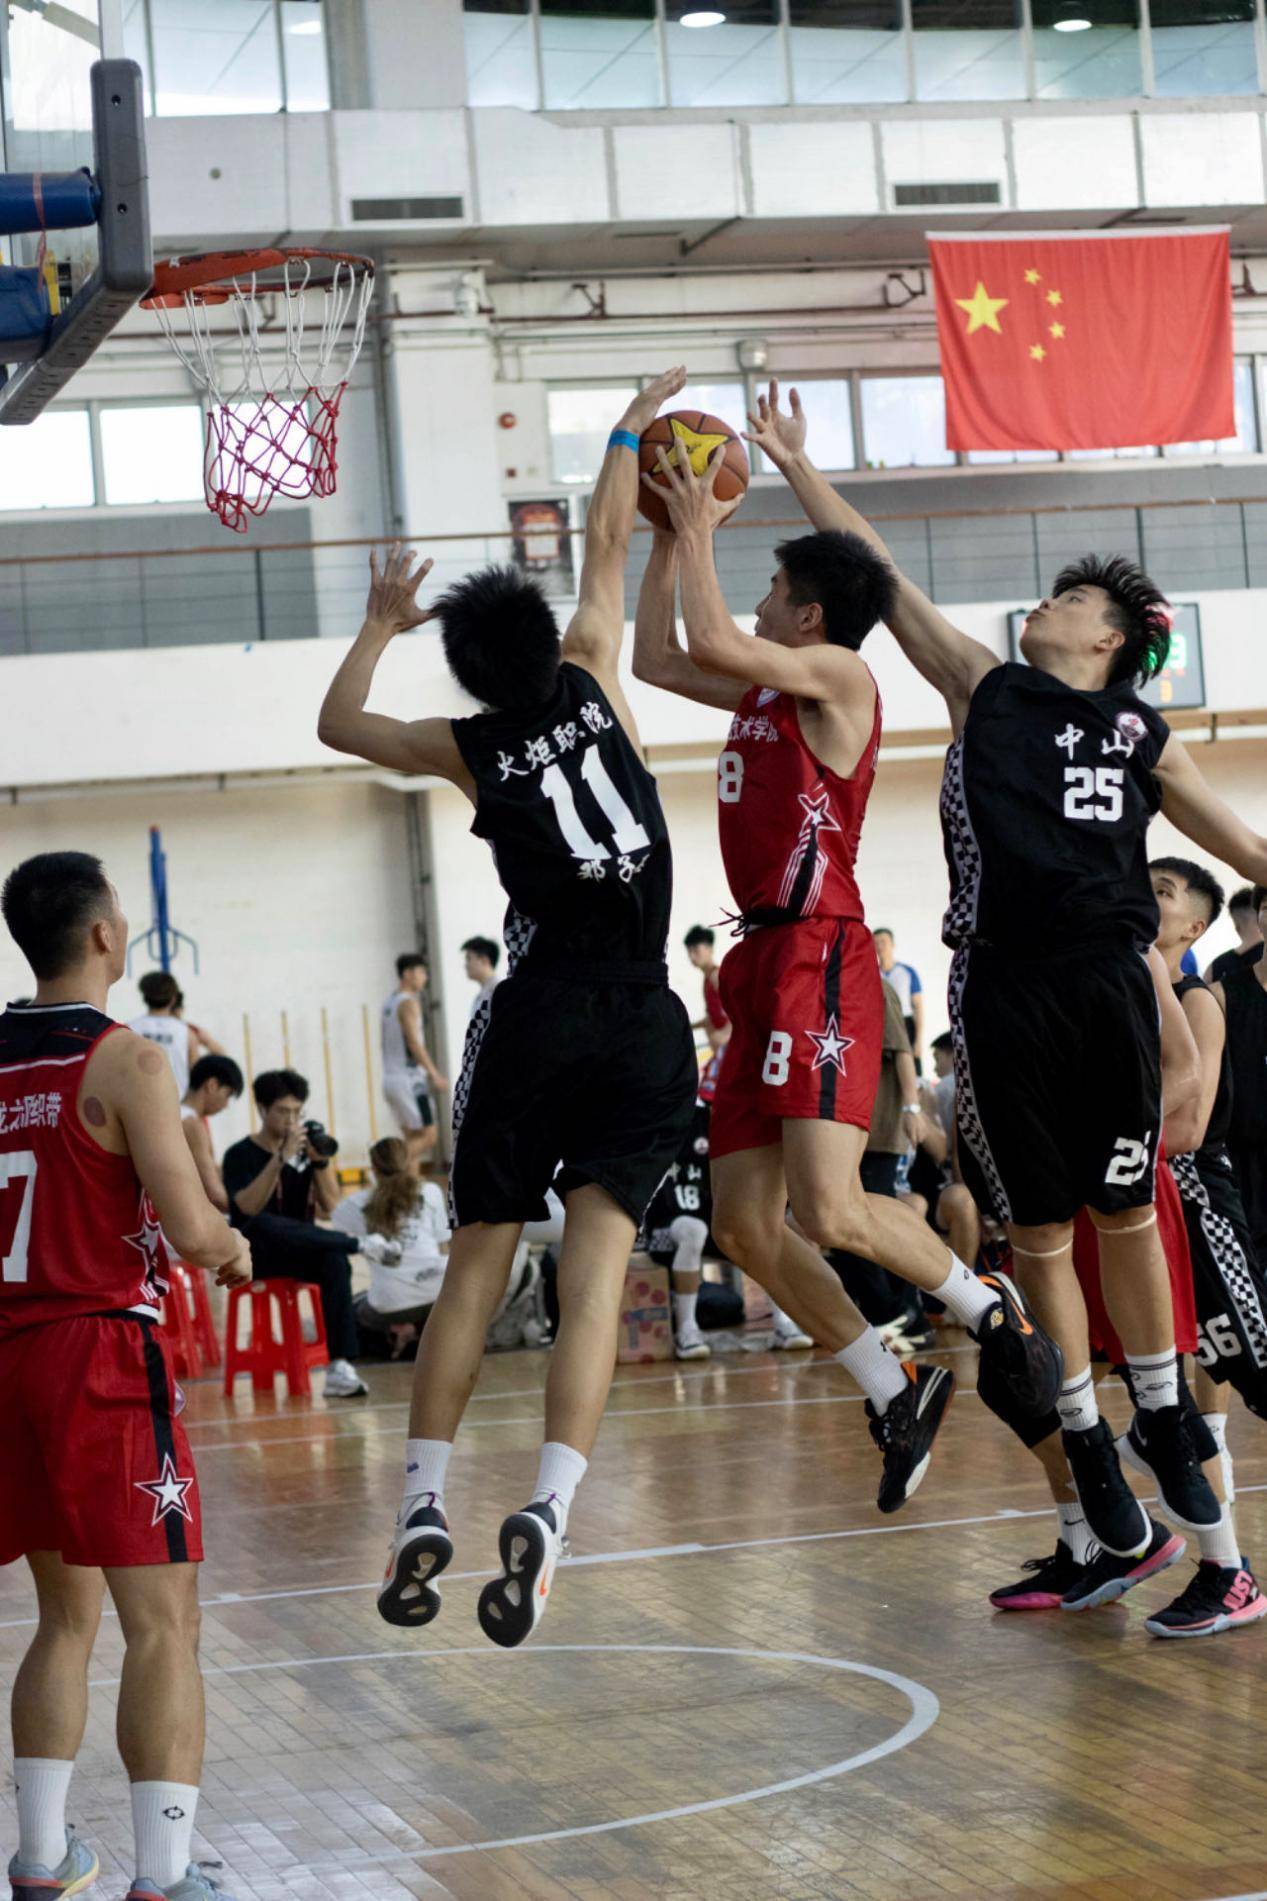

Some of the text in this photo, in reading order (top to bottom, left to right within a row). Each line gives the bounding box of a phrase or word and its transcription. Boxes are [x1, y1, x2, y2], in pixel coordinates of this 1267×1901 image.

[498, 701, 613, 782] 火炬职院
[1055, 722, 1135, 760] 中山
[540, 743, 651, 860] 11
[718, 751, 744, 803] 8
[1064, 766, 1124, 822] 25
[761, 1030, 793, 1086] 8
